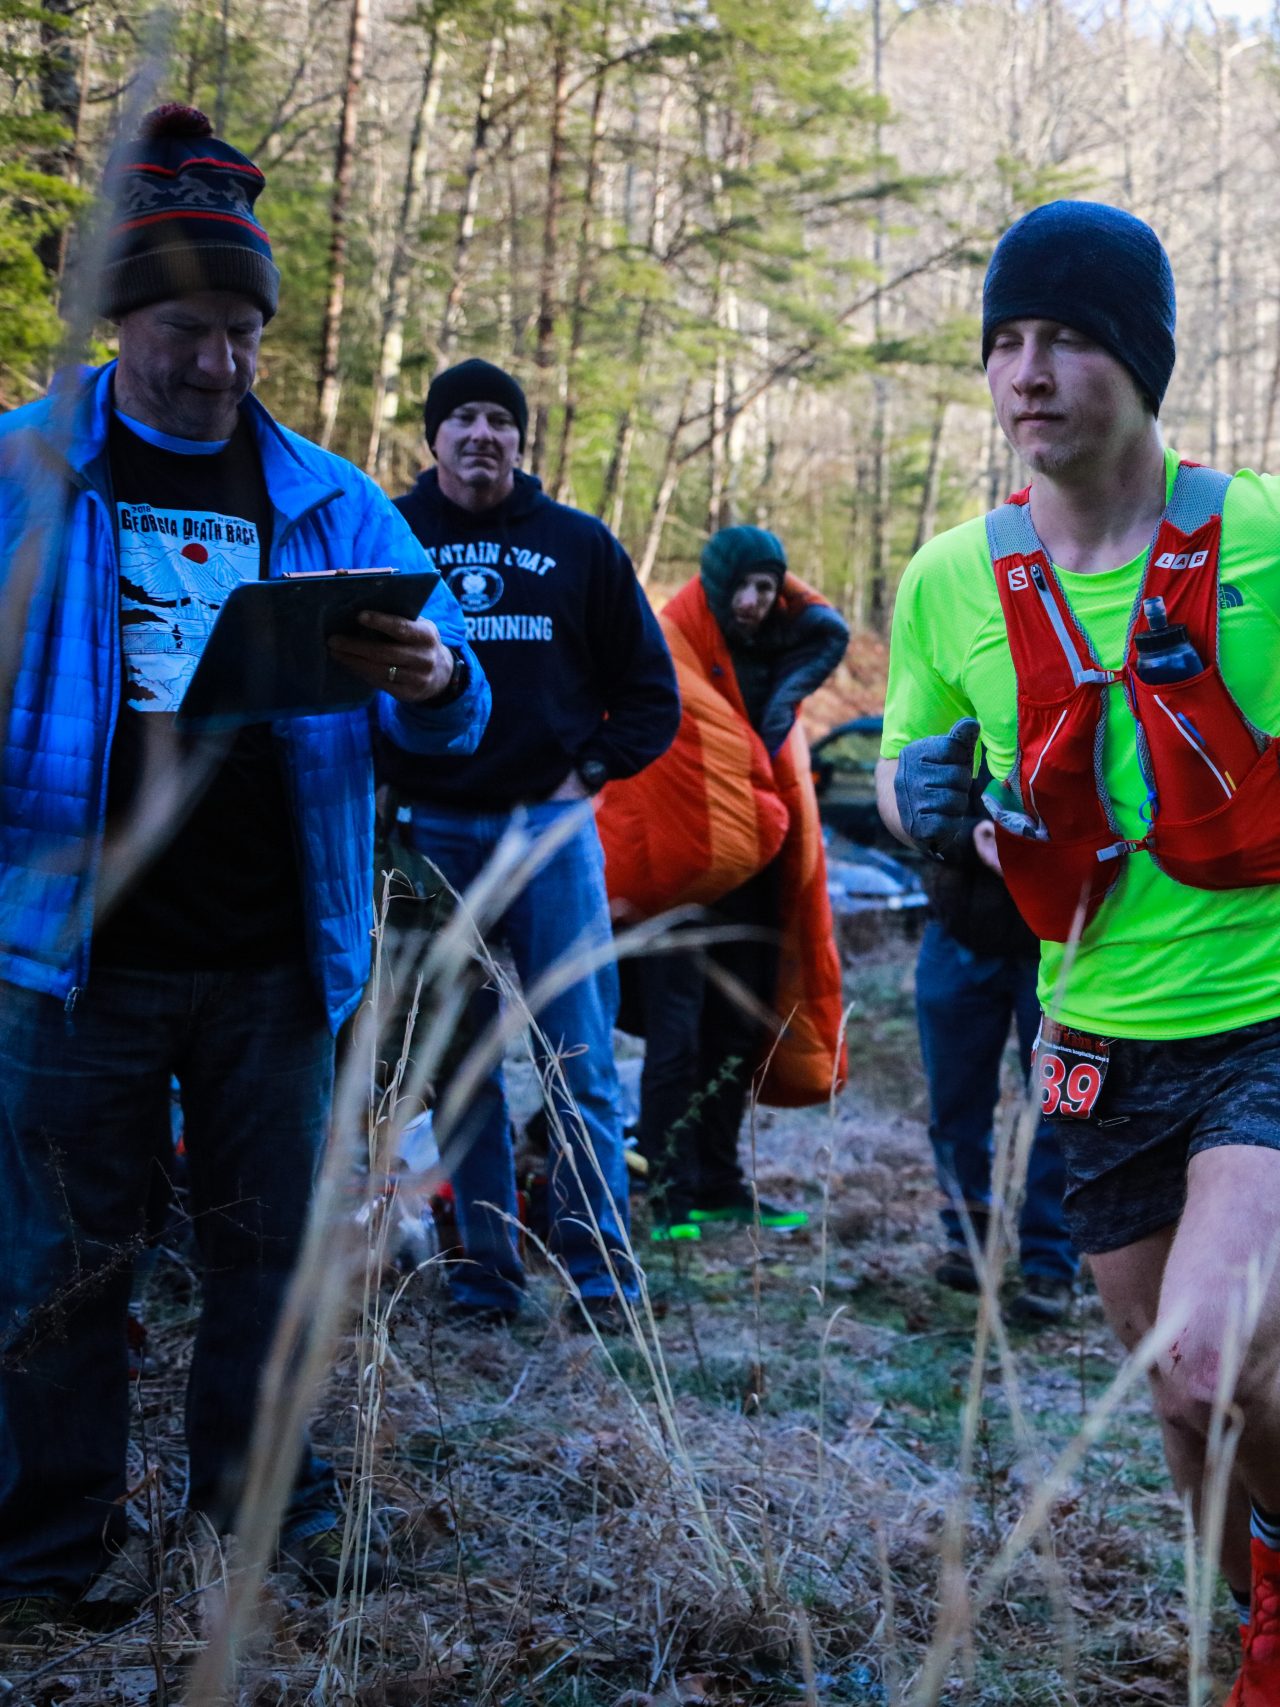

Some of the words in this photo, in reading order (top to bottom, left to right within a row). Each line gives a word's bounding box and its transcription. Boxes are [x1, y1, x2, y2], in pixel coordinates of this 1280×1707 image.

[131, 505, 151, 514] 2018
[121, 508, 179, 538] GEORGIA
[183, 517, 222, 541] DEATH
[226, 523, 256, 545] RACE
[1158, 552, 1206, 567] LAB
[1010, 567, 1027, 589] S
[465, 615, 553, 641] RUNNING
